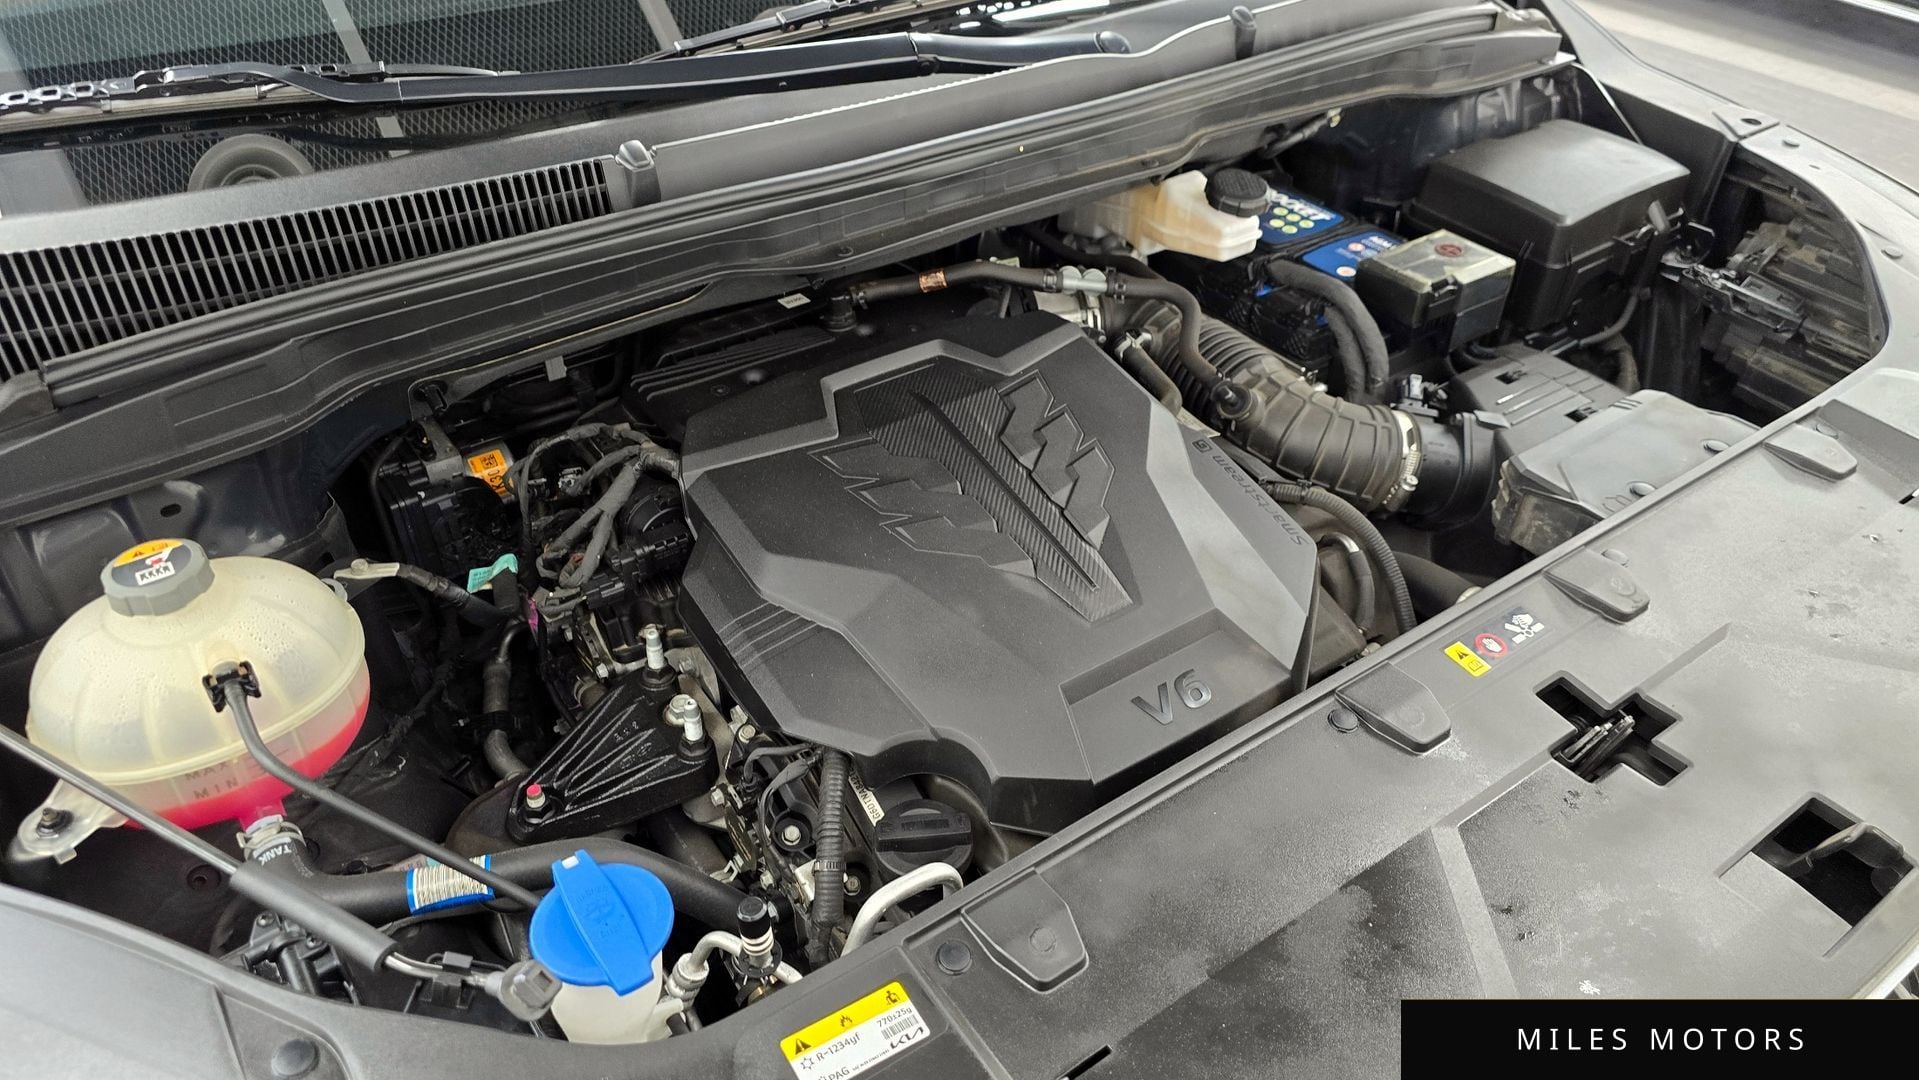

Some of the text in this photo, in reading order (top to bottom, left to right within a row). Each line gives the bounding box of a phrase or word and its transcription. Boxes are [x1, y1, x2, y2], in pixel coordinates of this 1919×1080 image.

[1212, 454, 1309, 546] Smartstream
[1130, 668, 1212, 726] V6
[185, 761, 230, 781] MAX
[193, 777, 238, 799] MIN
[258, 844, 292, 867] TANK
[816, 1031, 861, 1061] R-1234yf
[828, 1066, 850, 1080] PAG
